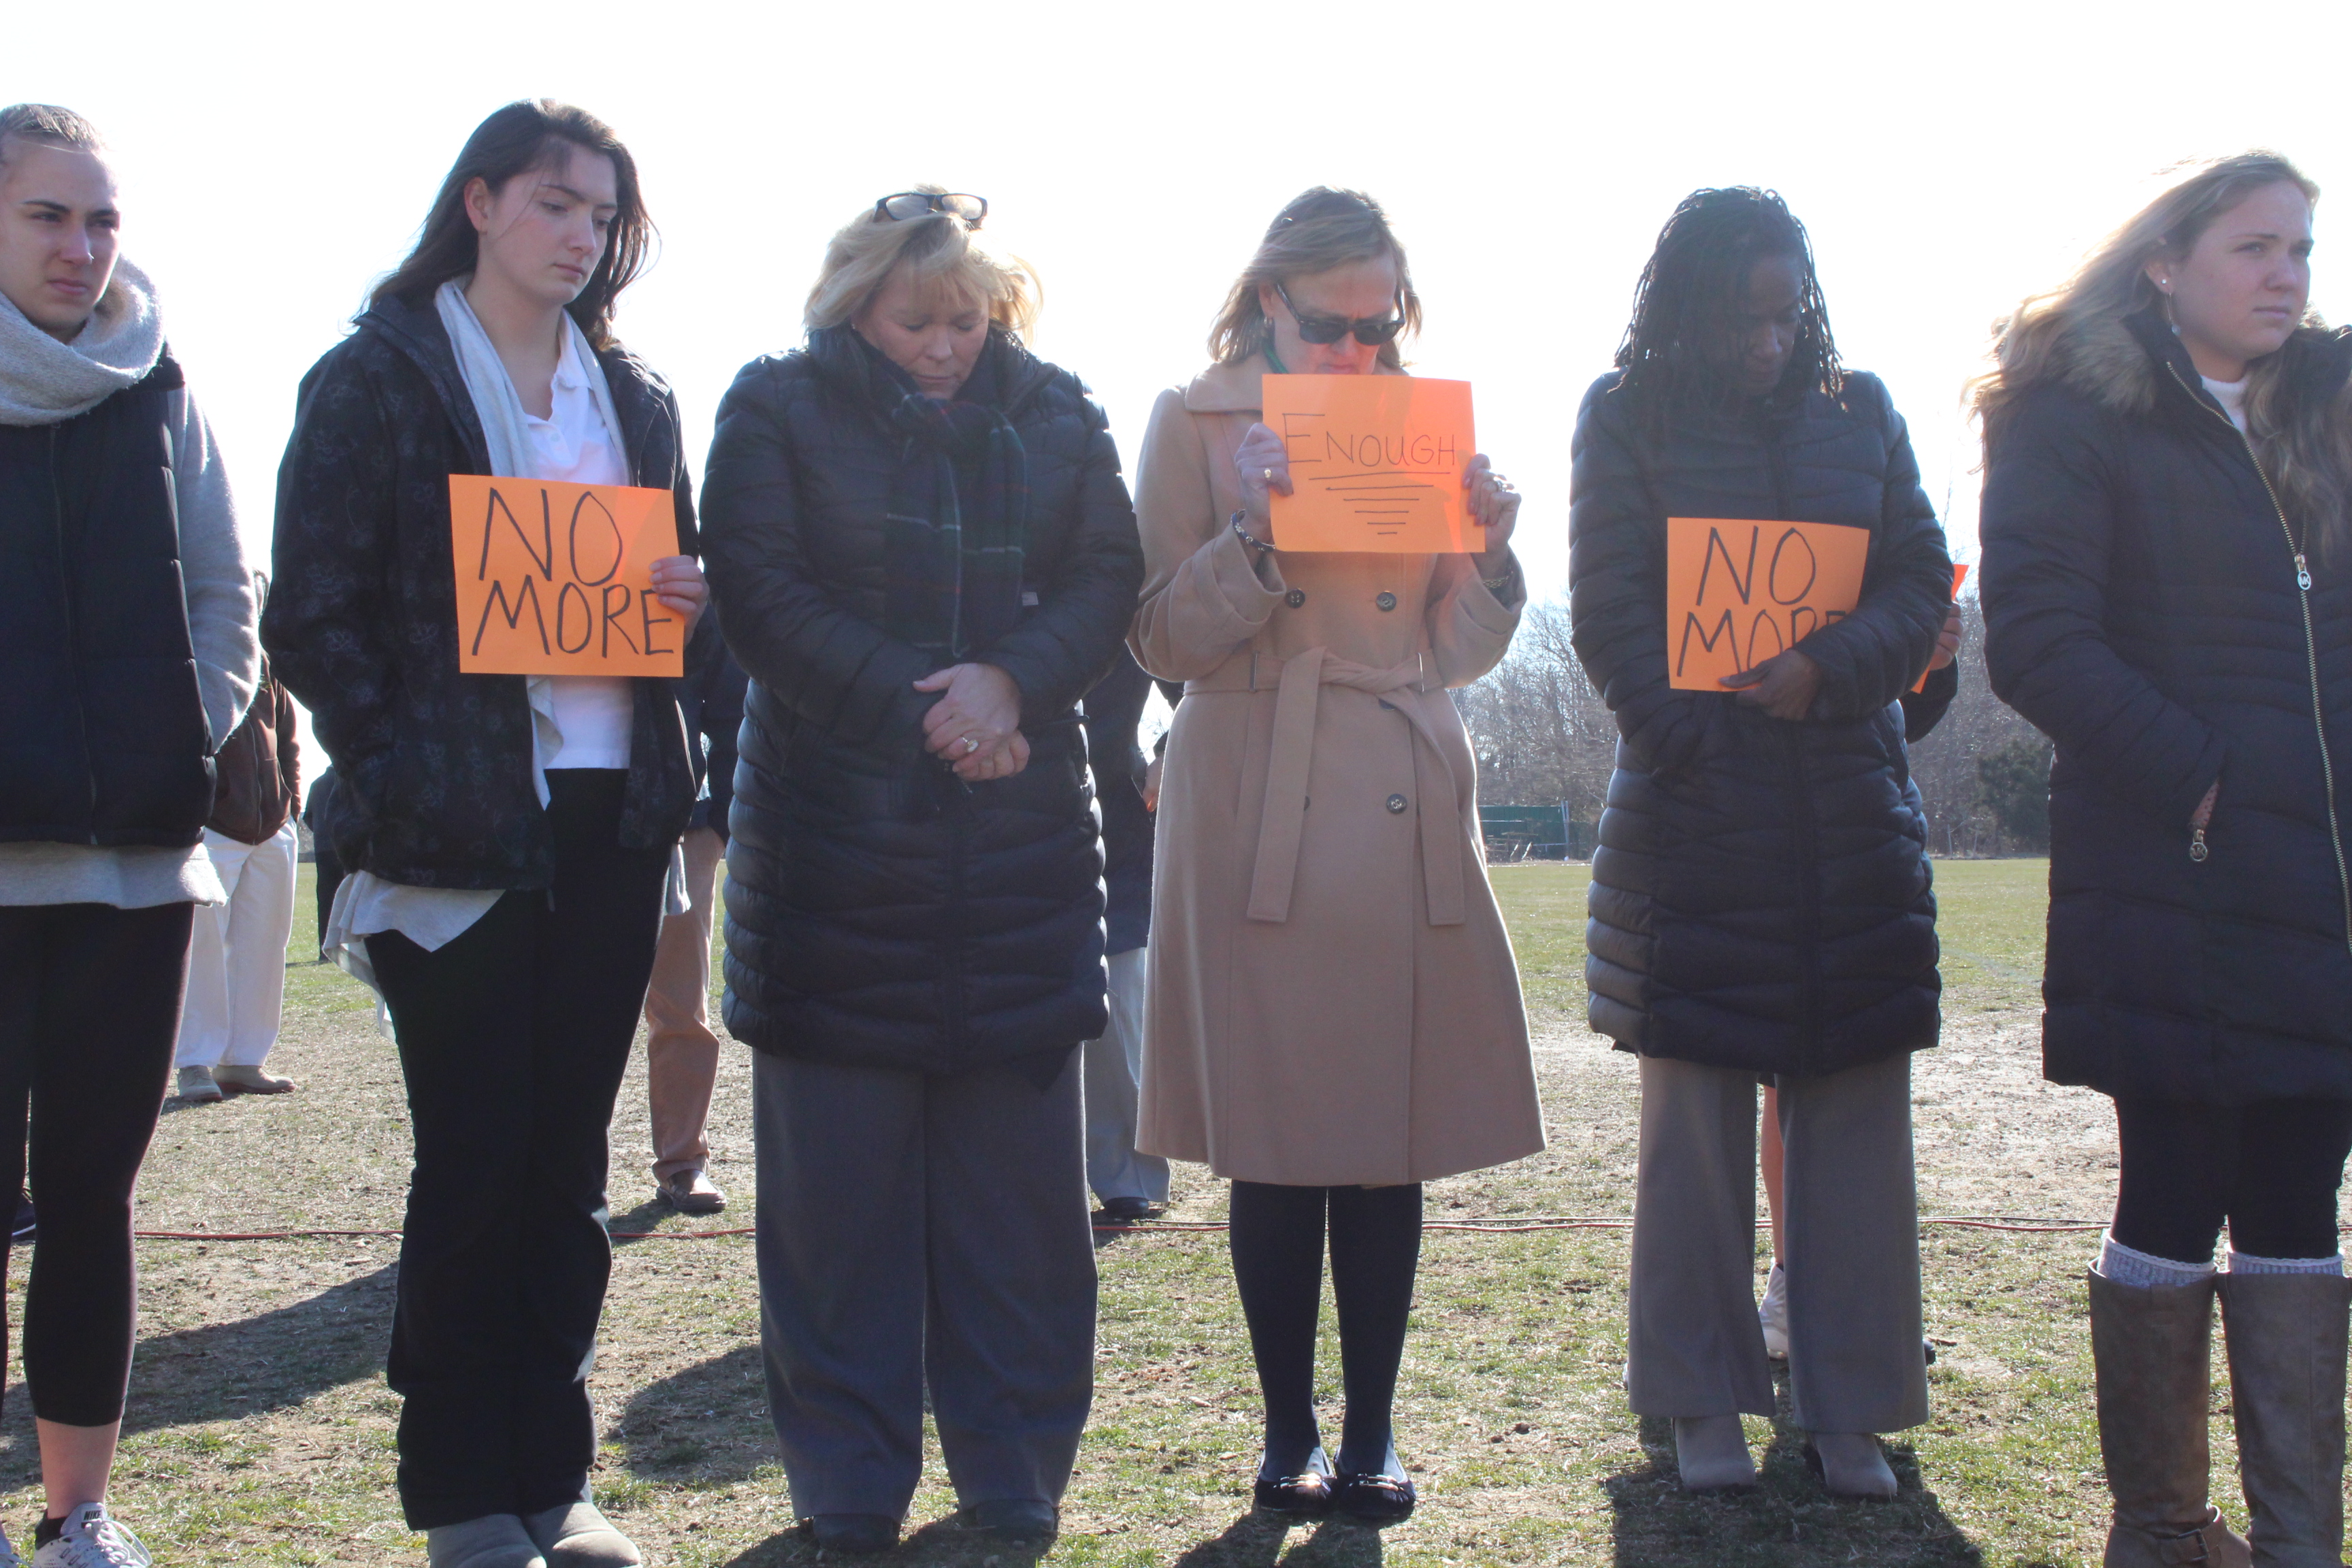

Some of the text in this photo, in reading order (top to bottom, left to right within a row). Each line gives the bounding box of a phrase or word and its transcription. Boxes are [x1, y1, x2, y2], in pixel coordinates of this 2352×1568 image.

[1282, 412, 1456, 467] ENOUGH
[478, 487, 623, 587] NO
[1696, 525, 1816, 606] NO
[472, 574, 674, 658] MORE
[1676, 606, 1846, 678] MOR
[84, 1510, 102, 1521] NIKE
